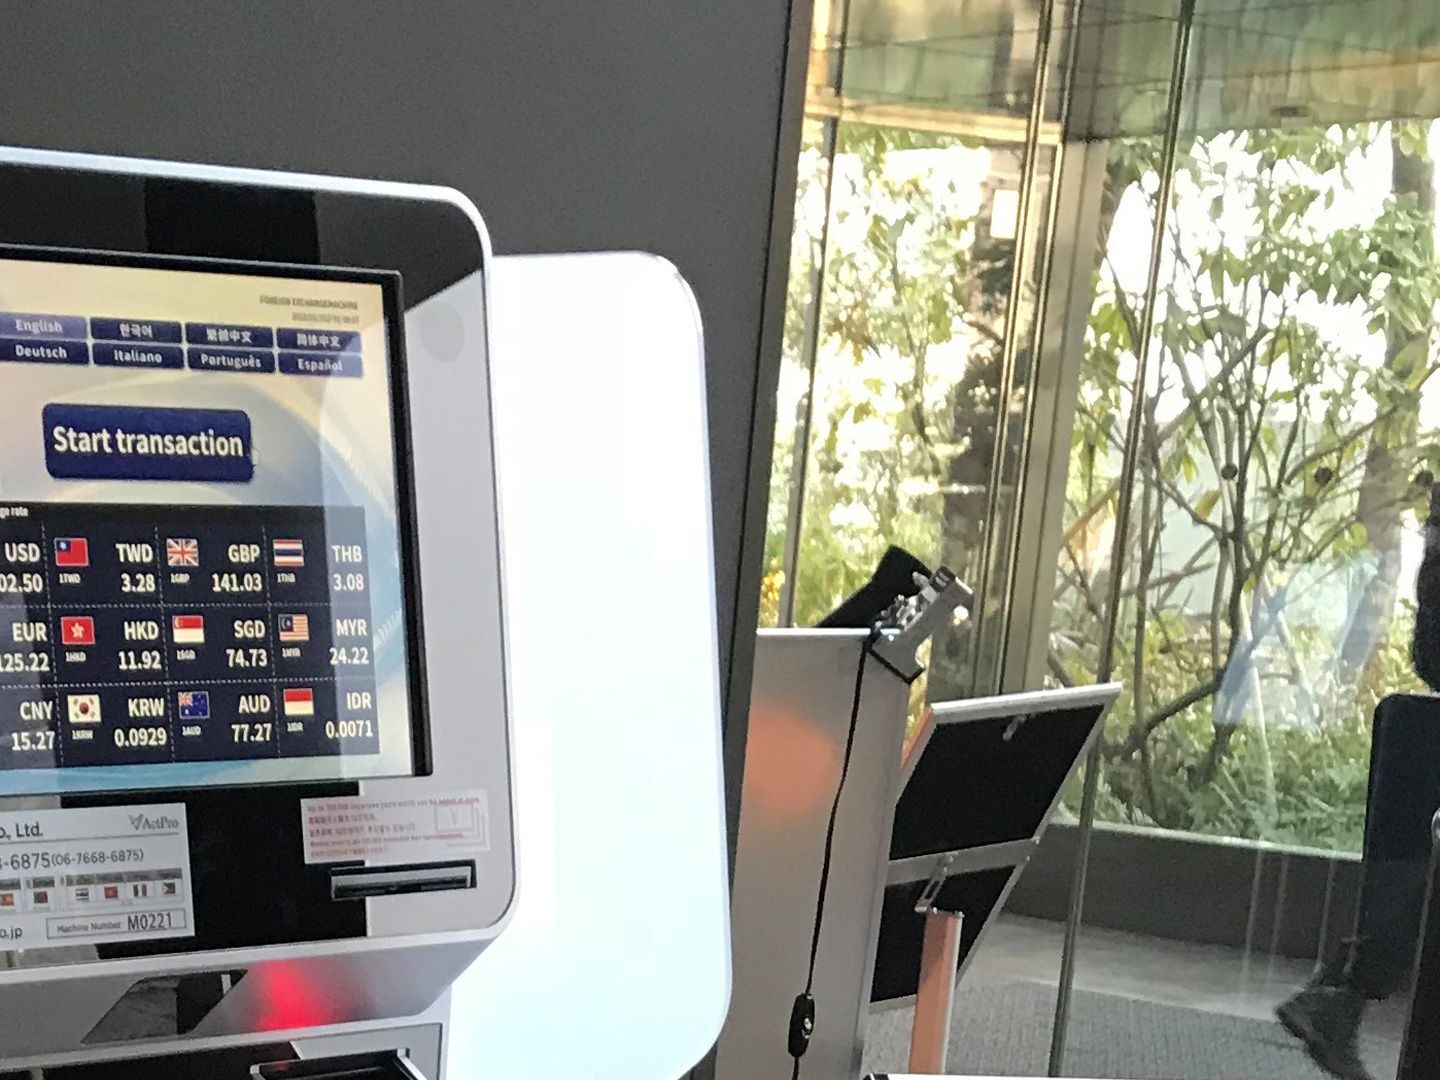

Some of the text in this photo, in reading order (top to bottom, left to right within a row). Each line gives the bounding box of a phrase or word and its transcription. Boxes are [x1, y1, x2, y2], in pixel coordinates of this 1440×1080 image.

[15, 319, 63, 334] English
[120, 323, 153, 338] 한국어
[15, 344, 67, 358] Deutsch
[114, 349, 162, 363] Italiano
[201, 353, 261, 369] Português
[298, 358, 343, 372] Español
[53, 426, 243, 457] Start transaction
[11, 507, 29, 517] rate
[4, 542, 40, 562] USD
[115, 543, 153, 562] TWD
[228, 544, 260, 563] GBP
[332, 545, 362, 562] THB
[121, 573, 155, 592] 3.28
[212, 573, 262, 592] 141.03
[333, 573, 364, 591] 3.08
[12, 622, 47, 642] EUR
[124, 621, 159, 640] HKD
[234, 620, 265, 638] SGD
[336, 619, 367, 636] MYR
[118, 651, 162, 670] 11.92
[226, 649, 268, 667] 74.73
[329, 647, 369, 665] 24.22
[128, 698, 165, 717] KRW
[238, 695, 270, 713] AUD
[347, 692, 371, 710] IDR
[20, 701, 53, 720] CNY
[114, 727, 167, 747] 0.0929
[231, 723, 272, 742] 77.27
[325, 720, 373, 739] 0.0071
[12, 731, 55, 751] 15.27
[15, 822, 43, 837] Ltd.
[127, 912, 173, 931] M0221
